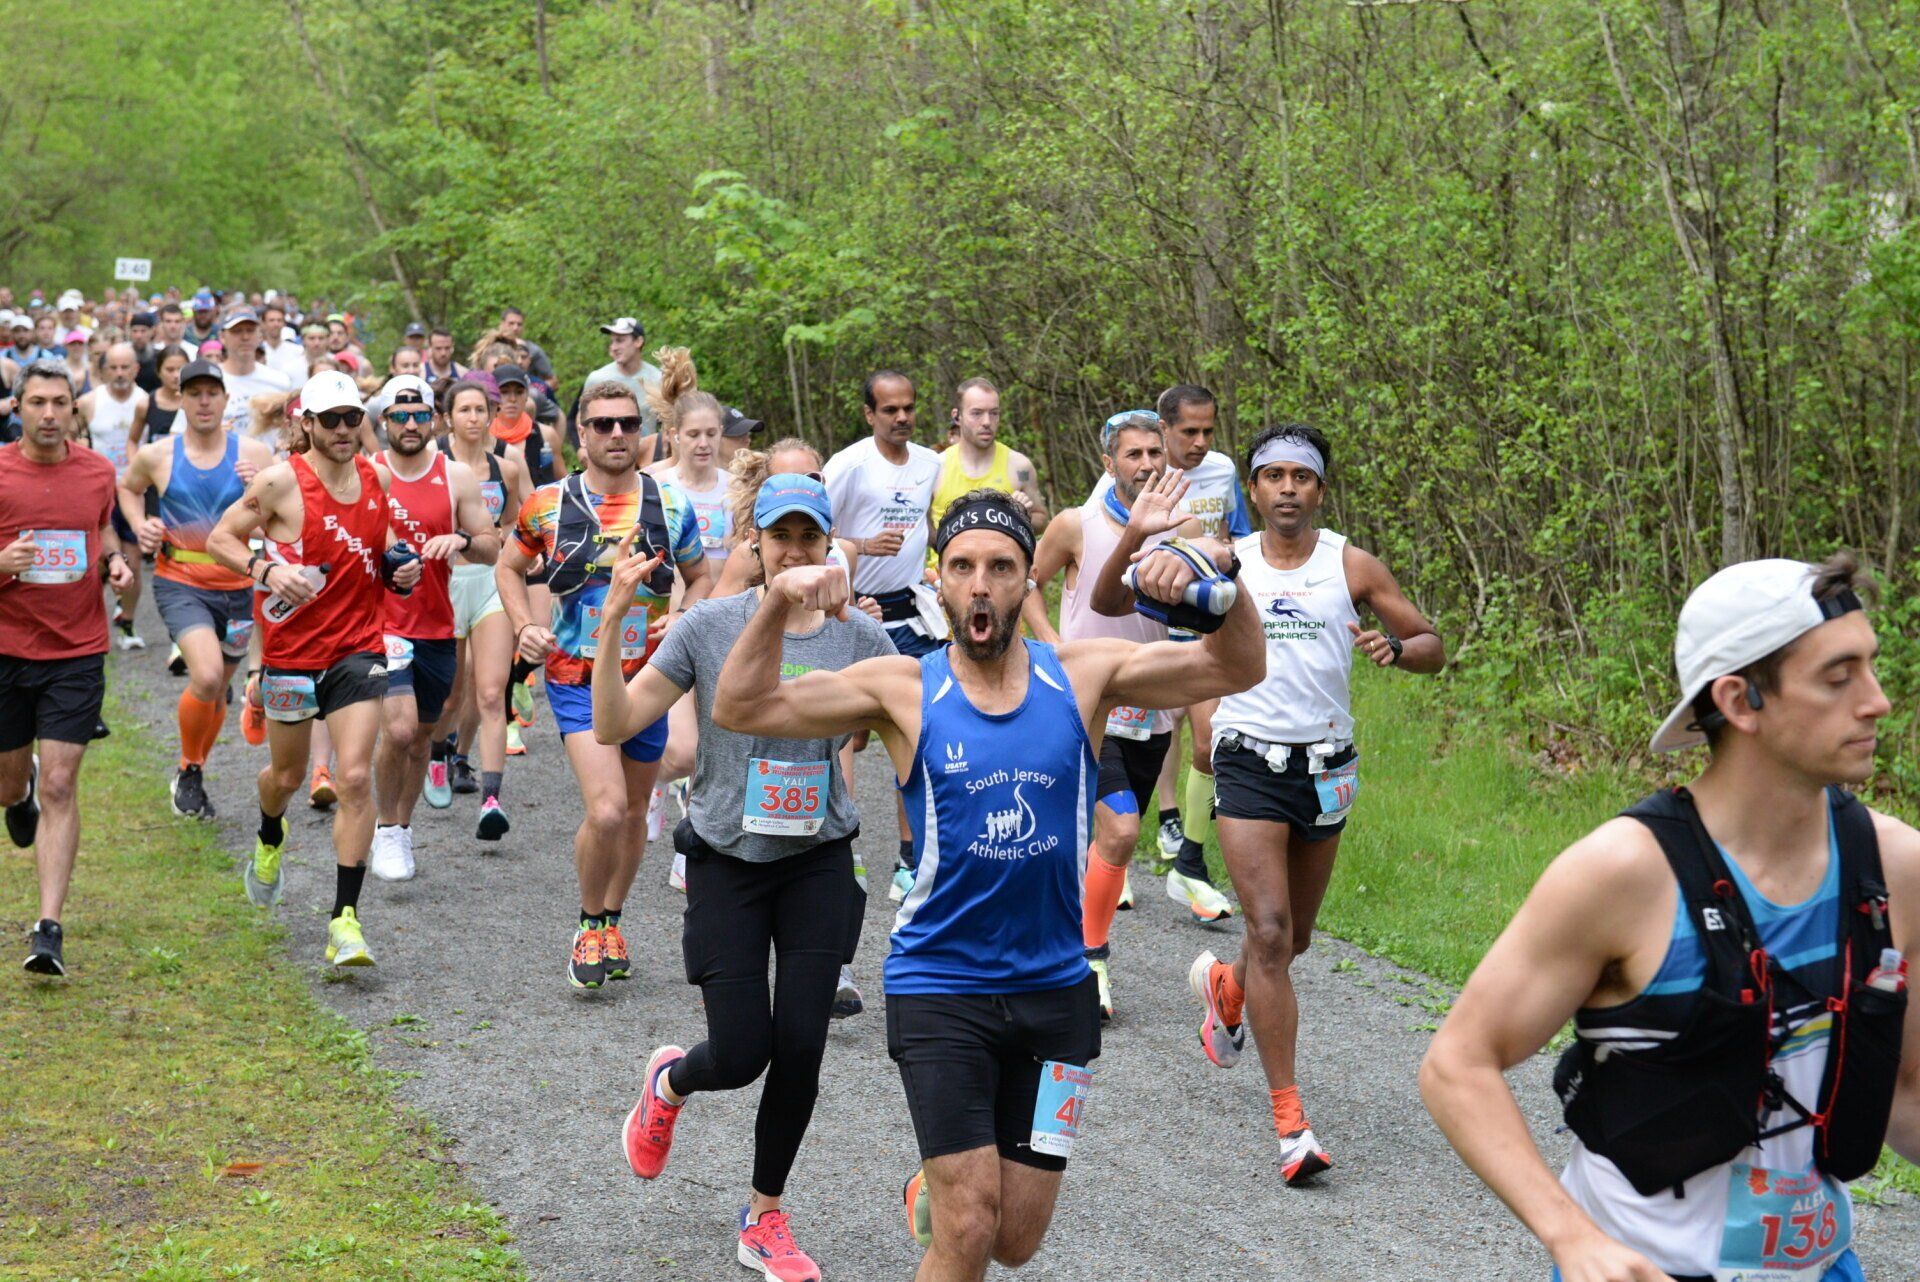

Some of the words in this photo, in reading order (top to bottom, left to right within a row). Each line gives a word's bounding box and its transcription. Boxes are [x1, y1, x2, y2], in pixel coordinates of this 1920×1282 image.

[386, 493, 426, 544] ASTO
[946, 511, 979, 540] Let's
[985, 508, 1015, 530] GO!
[31, 547, 78, 568] 355
[589, 624, 639, 643] 46
[1263, 620, 1326, 630] ARATHON
[265, 690, 305, 708] 227
[945, 761, 968, 770] USATF
[783, 777, 807, 786] YALI
[965, 769, 1008, 794] South
[1012, 768, 1056, 789] Jersey
[759, 784, 820, 813] 385
[967, 841, 1024, 860] Athletic
[1028, 835, 1058, 856] Club
[1760, 1201, 1838, 1259] 138
